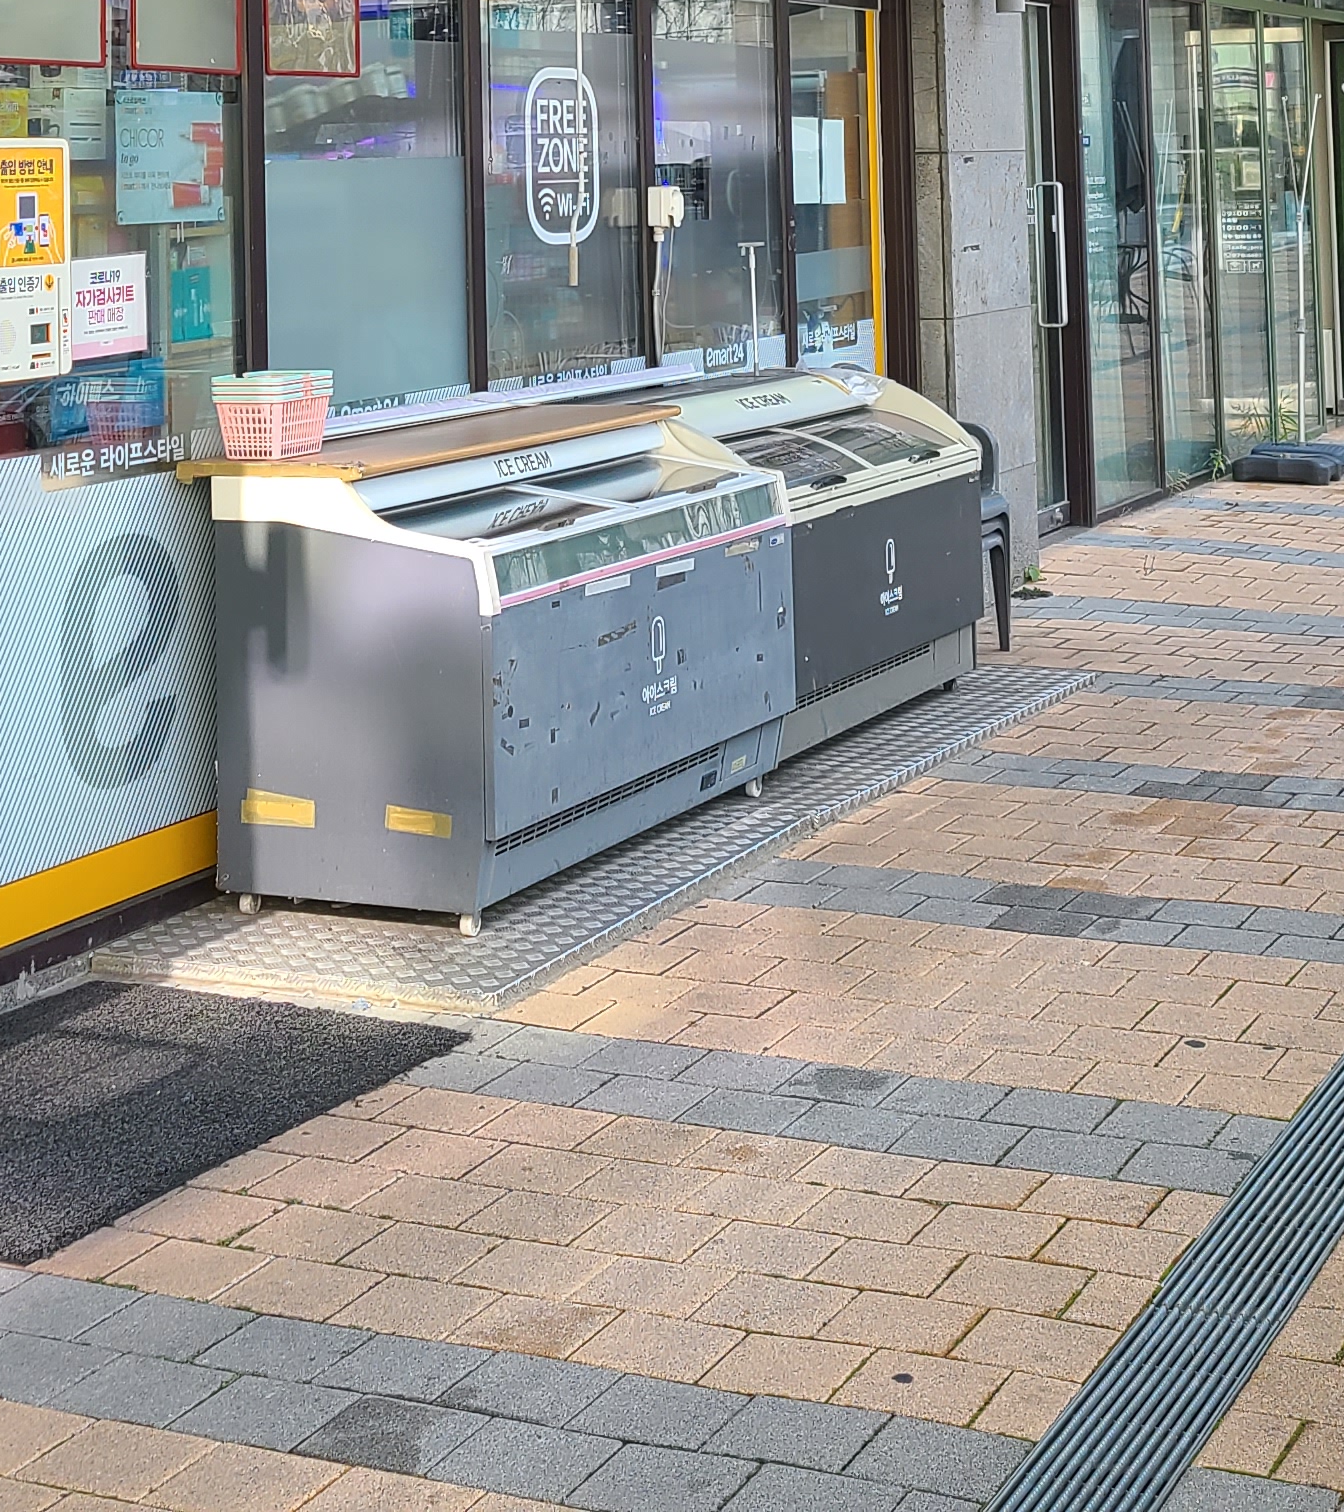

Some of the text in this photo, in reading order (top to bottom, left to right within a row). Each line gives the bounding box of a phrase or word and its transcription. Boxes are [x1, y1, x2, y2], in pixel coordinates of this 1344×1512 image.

[536, 99, 587, 134] FREE
[120, 128, 164, 148] CHICOR
[537, 138, 588, 173] ZONE
[0, 274, 43, 294] 출입 인증기
[90, 270, 121, 284] 코로나19
[76, 285, 134, 308] 자가검사키트
[88, 306, 124, 325] 판매 매장
[706, 343, 745, 368] emart24
[50, 434, 185, 480] 새로운 라이프스타일
[494, 450, 552, 478] ICE CREAM
[642, 675, 677, 704] 아이스크림
